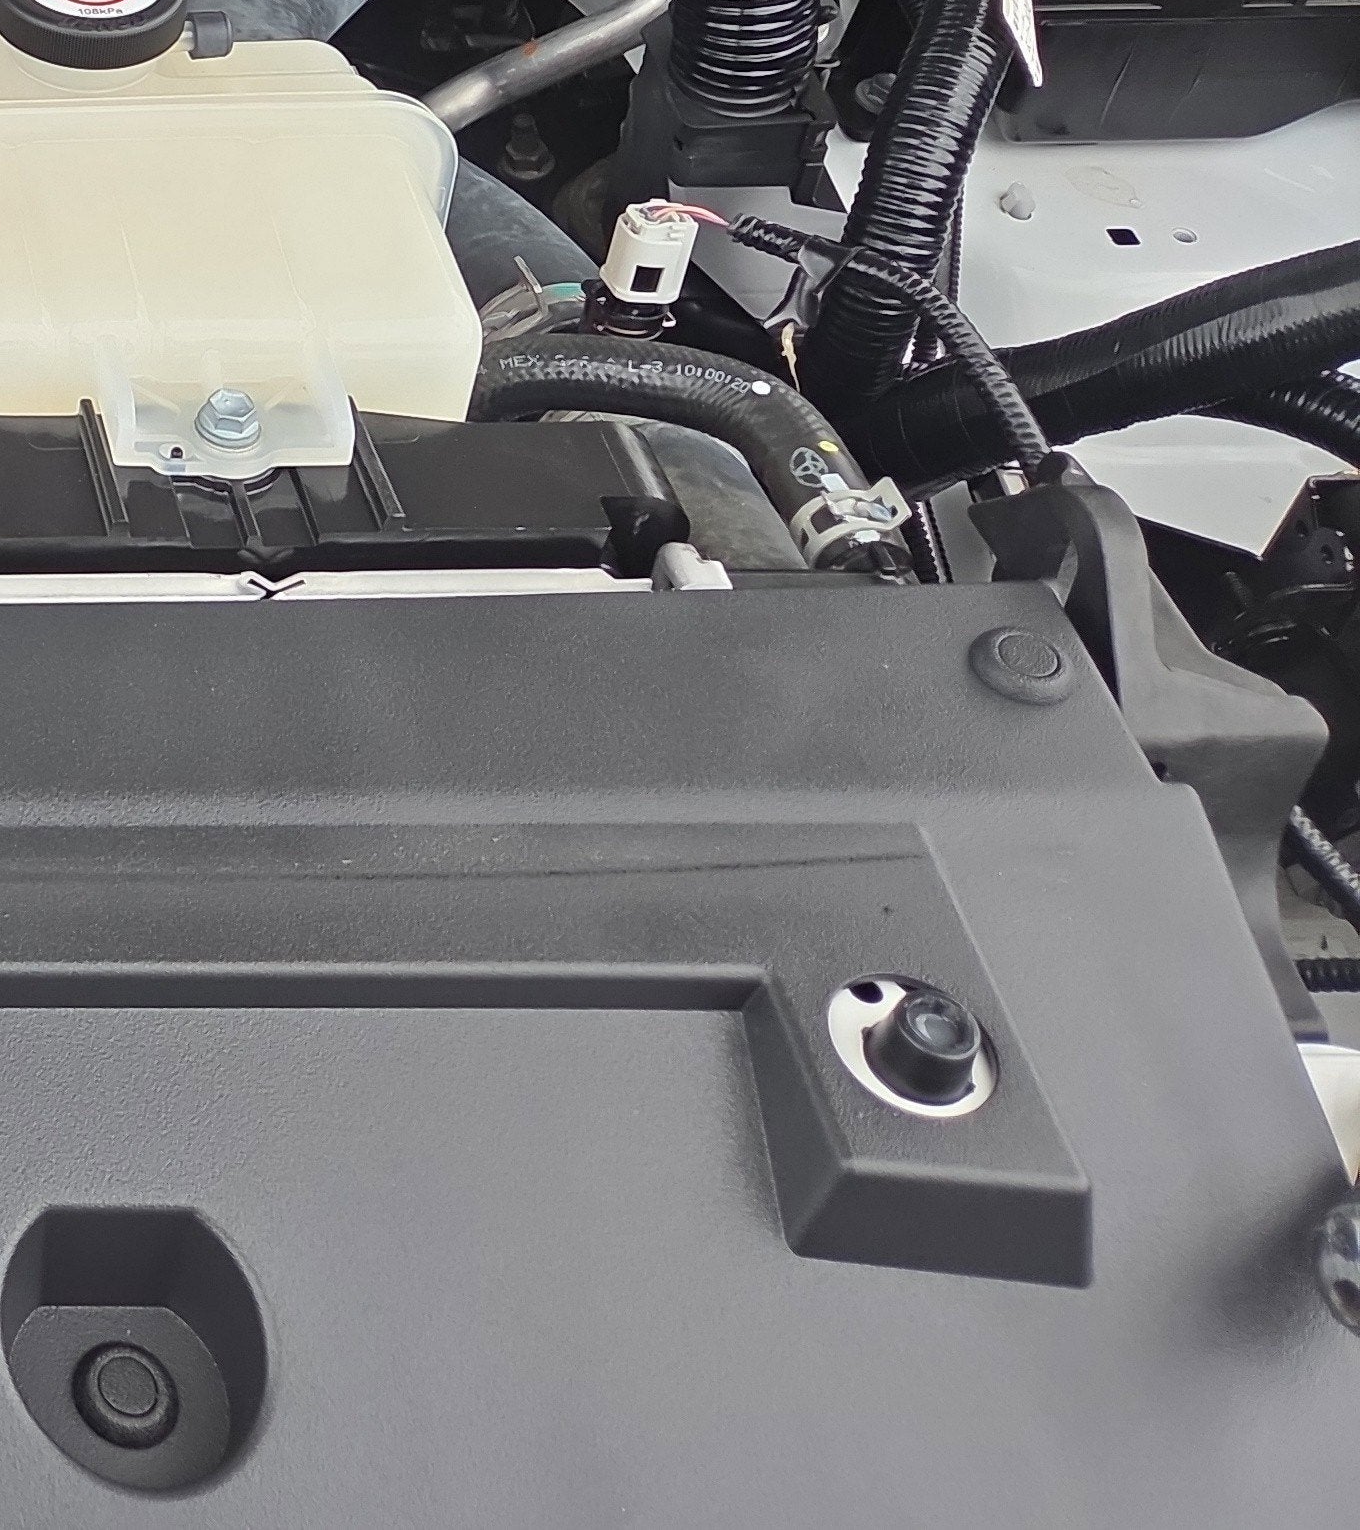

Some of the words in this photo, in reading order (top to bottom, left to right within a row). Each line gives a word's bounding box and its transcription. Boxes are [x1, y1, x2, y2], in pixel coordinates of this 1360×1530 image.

[77, 7, 124, 16] 108kPa
[499, 354, 541, 371] MEX
[627, 360, 664, 374] L-3
